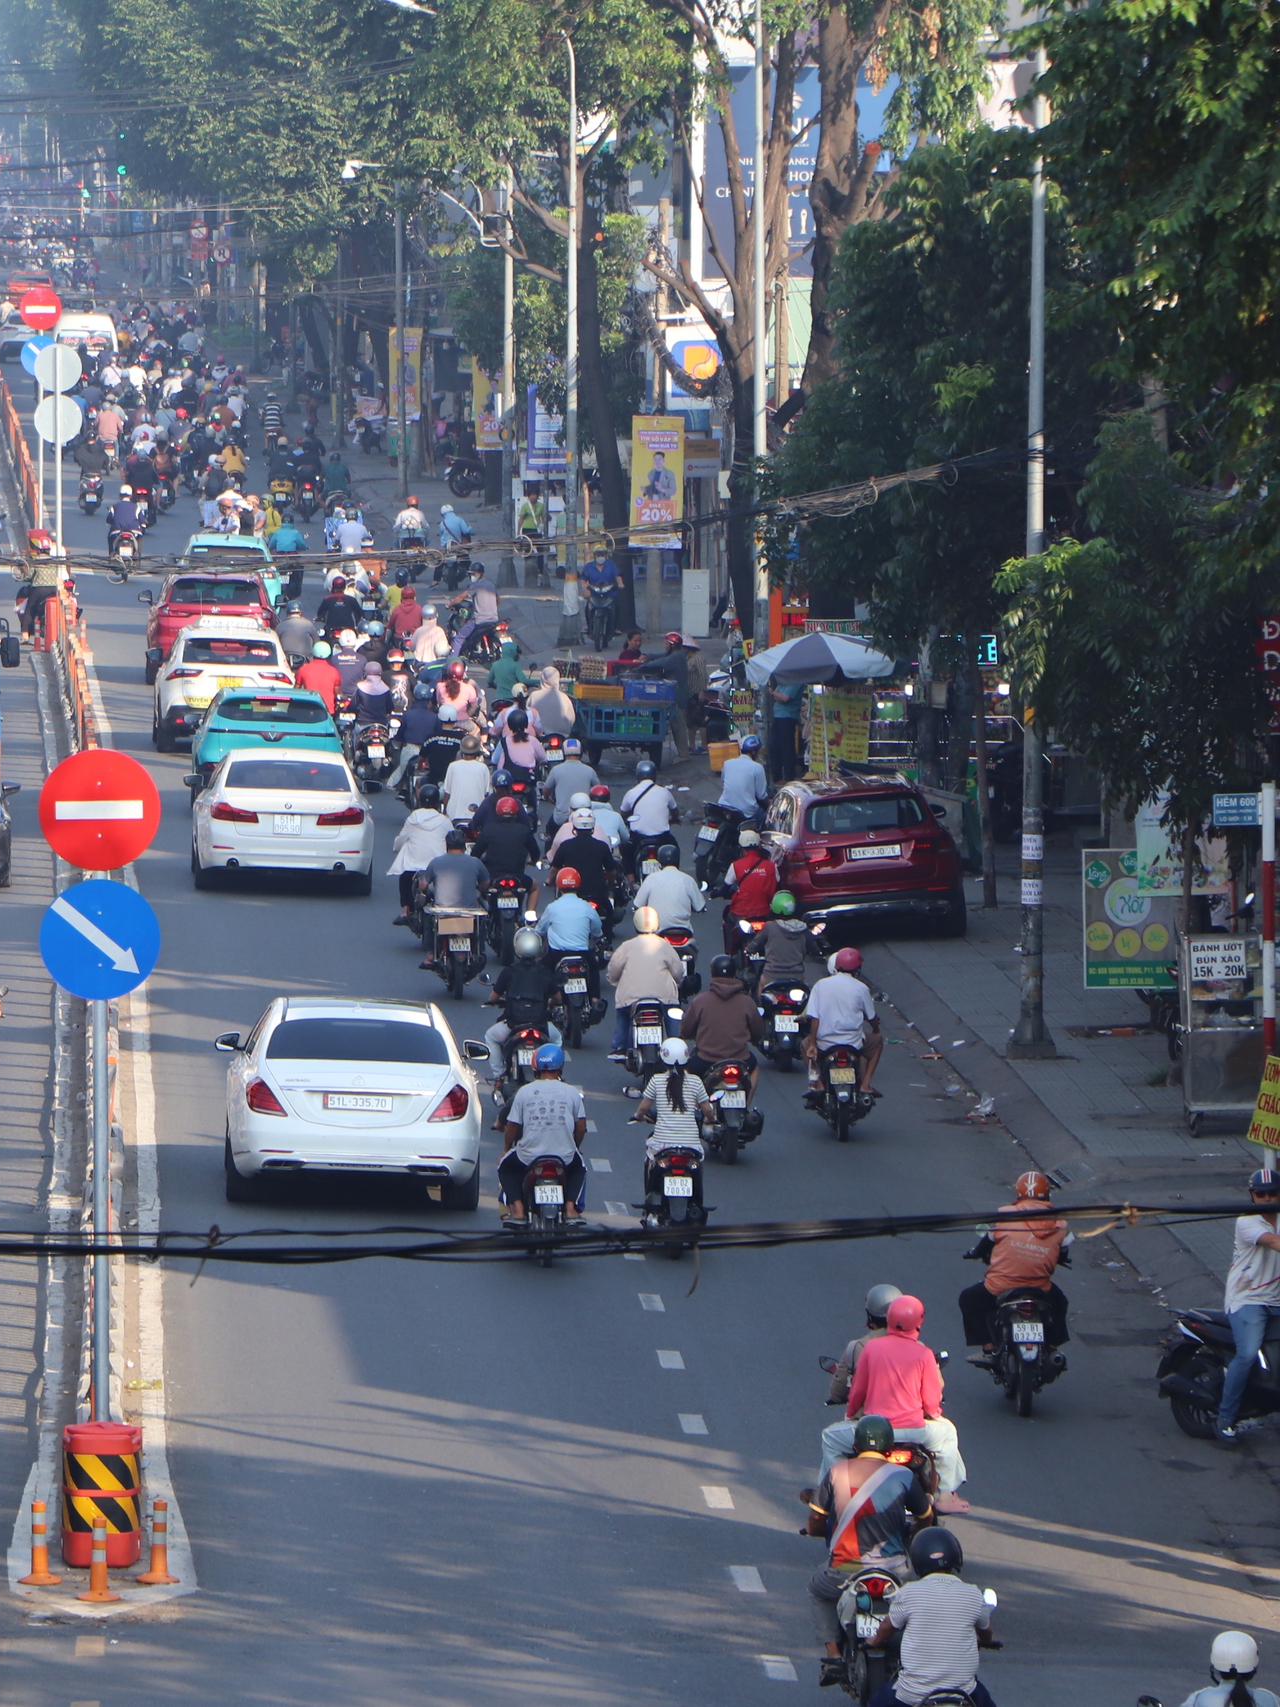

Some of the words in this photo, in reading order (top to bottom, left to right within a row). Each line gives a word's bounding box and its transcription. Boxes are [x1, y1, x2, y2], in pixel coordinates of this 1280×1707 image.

[641, 508, 672, 521] 20%
[1240, 797, 1255, 806] 600
[1193, 943, 1220, 953] BÁNH
[1223, 942, 1243, 951] ƯỚT
[1196, 955, 1217, 964] BÚN
[1221, 954, 1241, 963] XÀO
[1194, 966, 1214, 978] 15K
[1224, 965, 1245, 976] 20K
[329, 1096, 386, 1108] 51L-335.70
